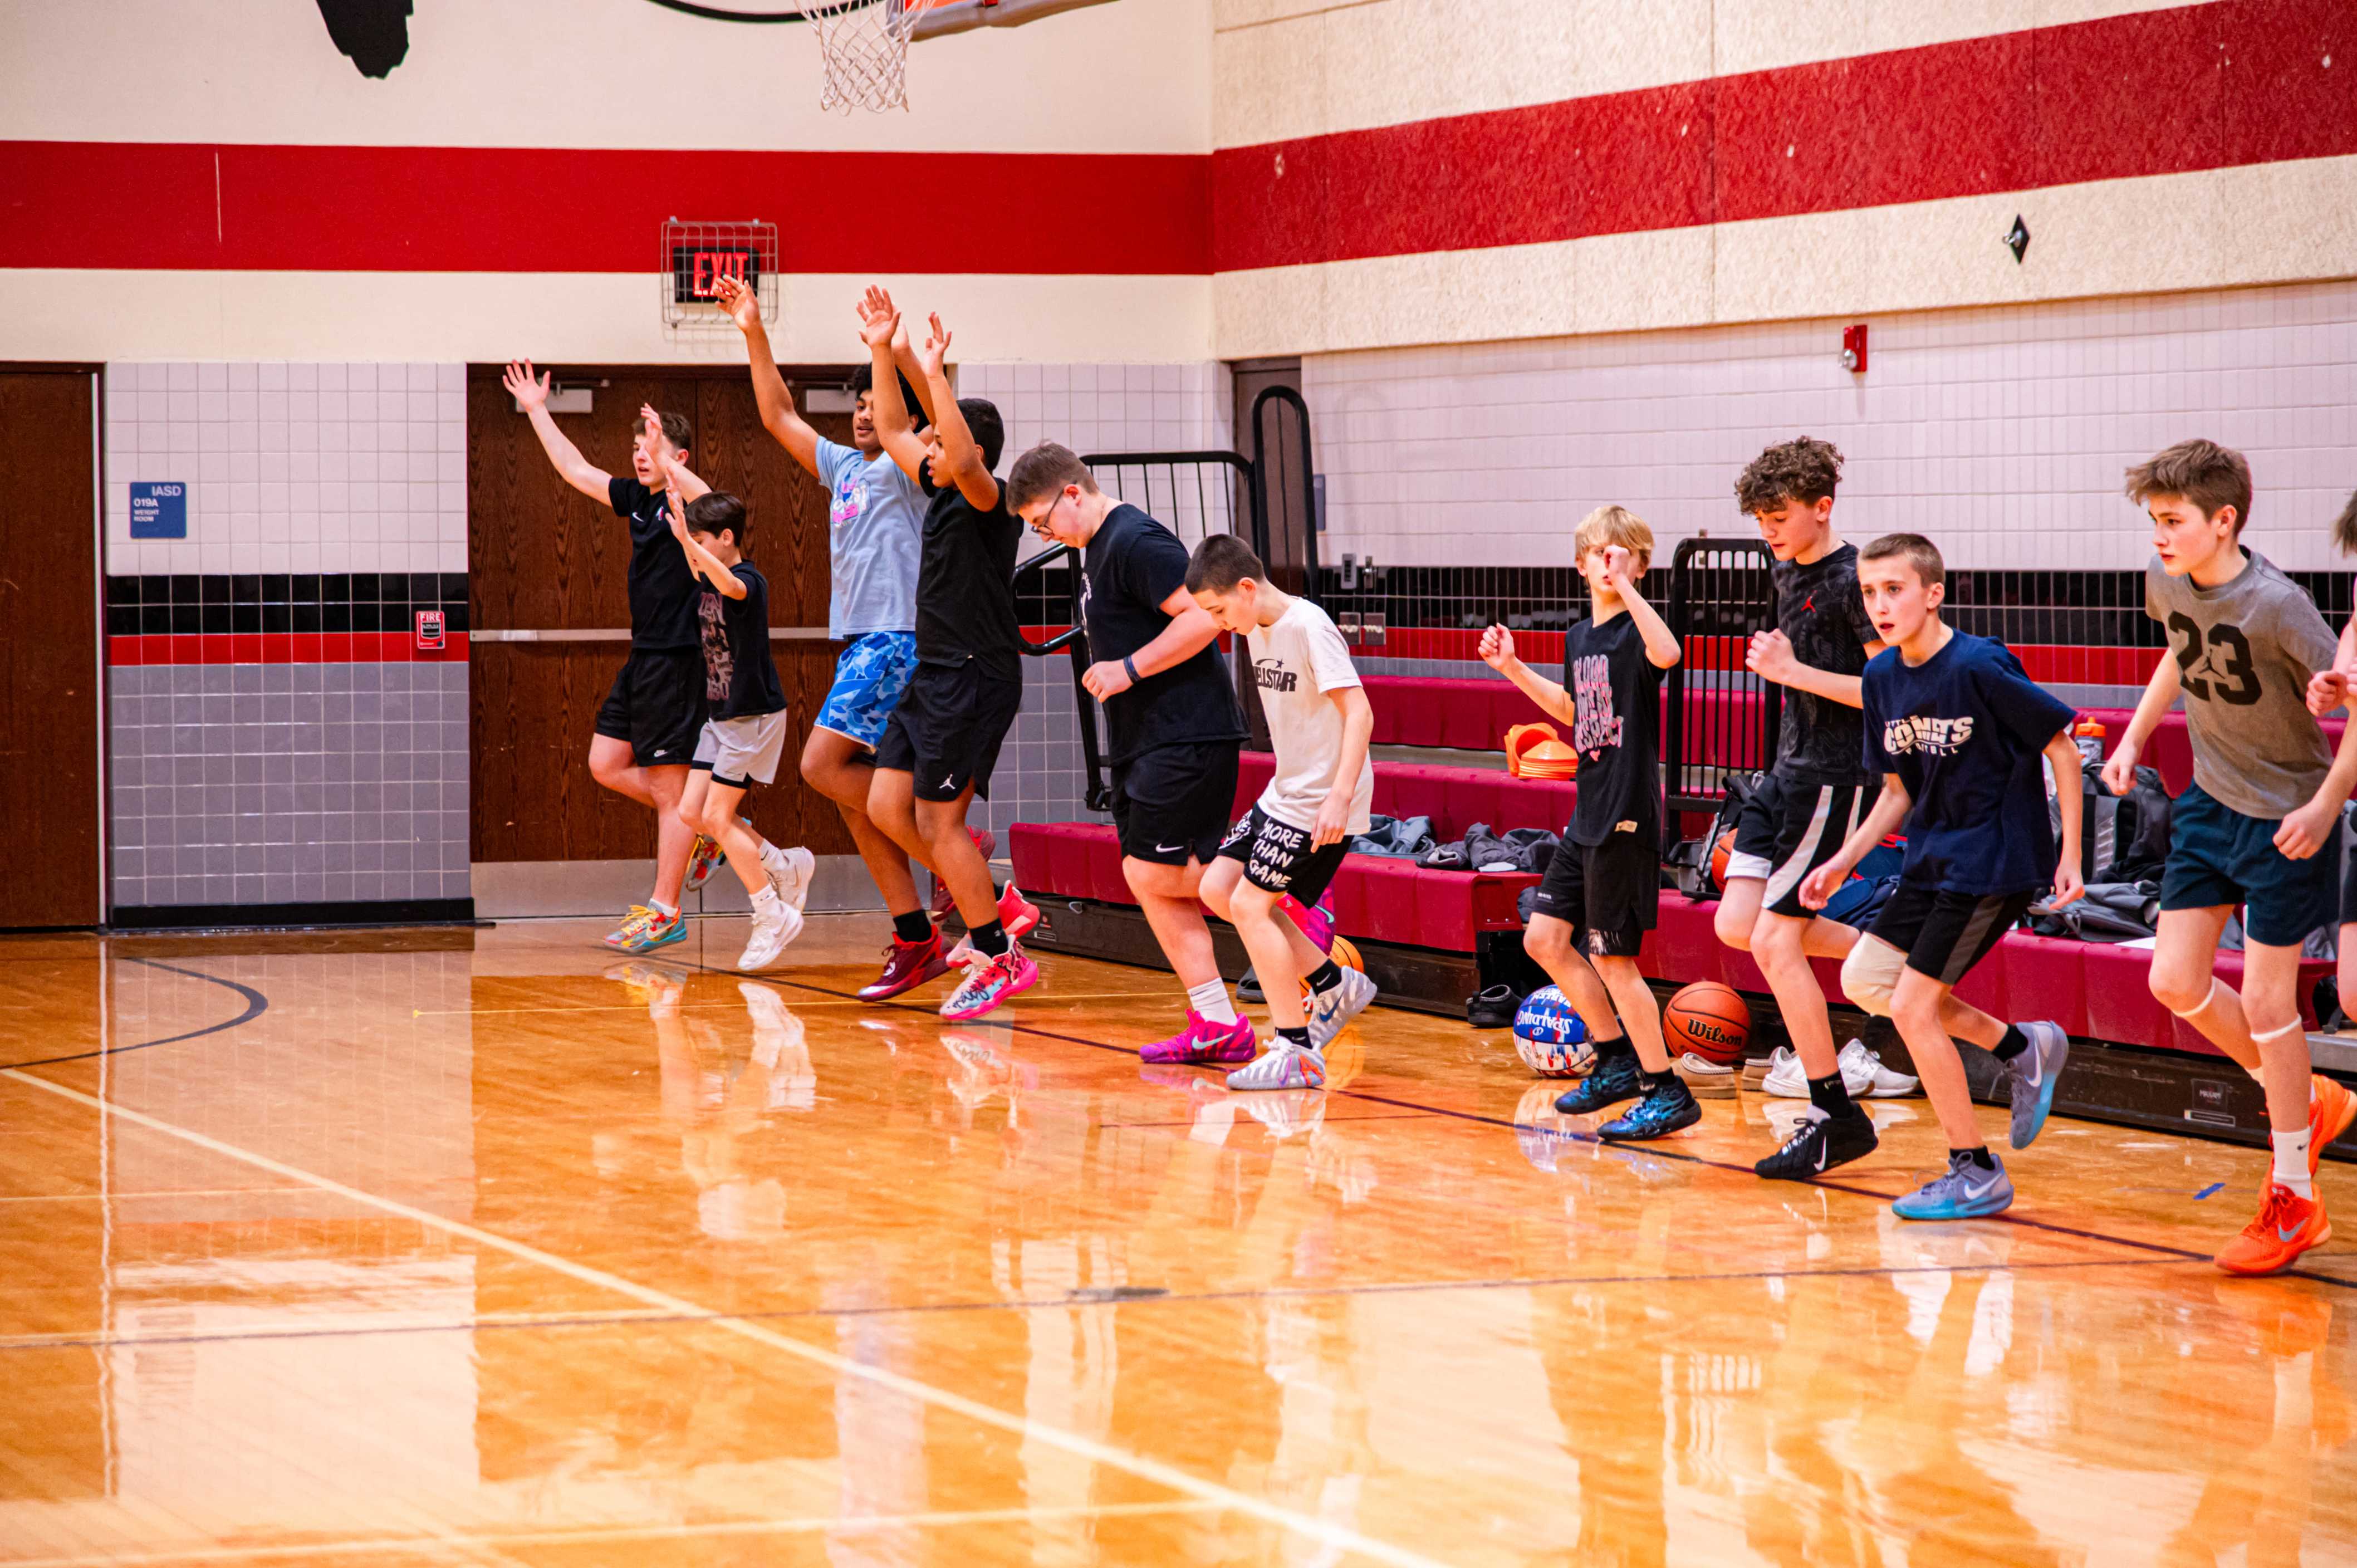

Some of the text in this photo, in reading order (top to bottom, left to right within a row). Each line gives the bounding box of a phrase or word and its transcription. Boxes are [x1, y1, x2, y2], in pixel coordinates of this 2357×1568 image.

[694, 252, 748, 296] EXIT
[134, 498, 159, 507] 019A
[152, 485, 182, 496] IASD
[2168, 611, 2262, 705] 23
[1259, 817, 1304, 849] MORE
[1253, 838, 1294, 868] THAN
[1249, 859, 1292, 888] GAME
[1517, 1011, 1573, 1035] SPALDING
[1688, 1018, 1742, 1046] Wilson
